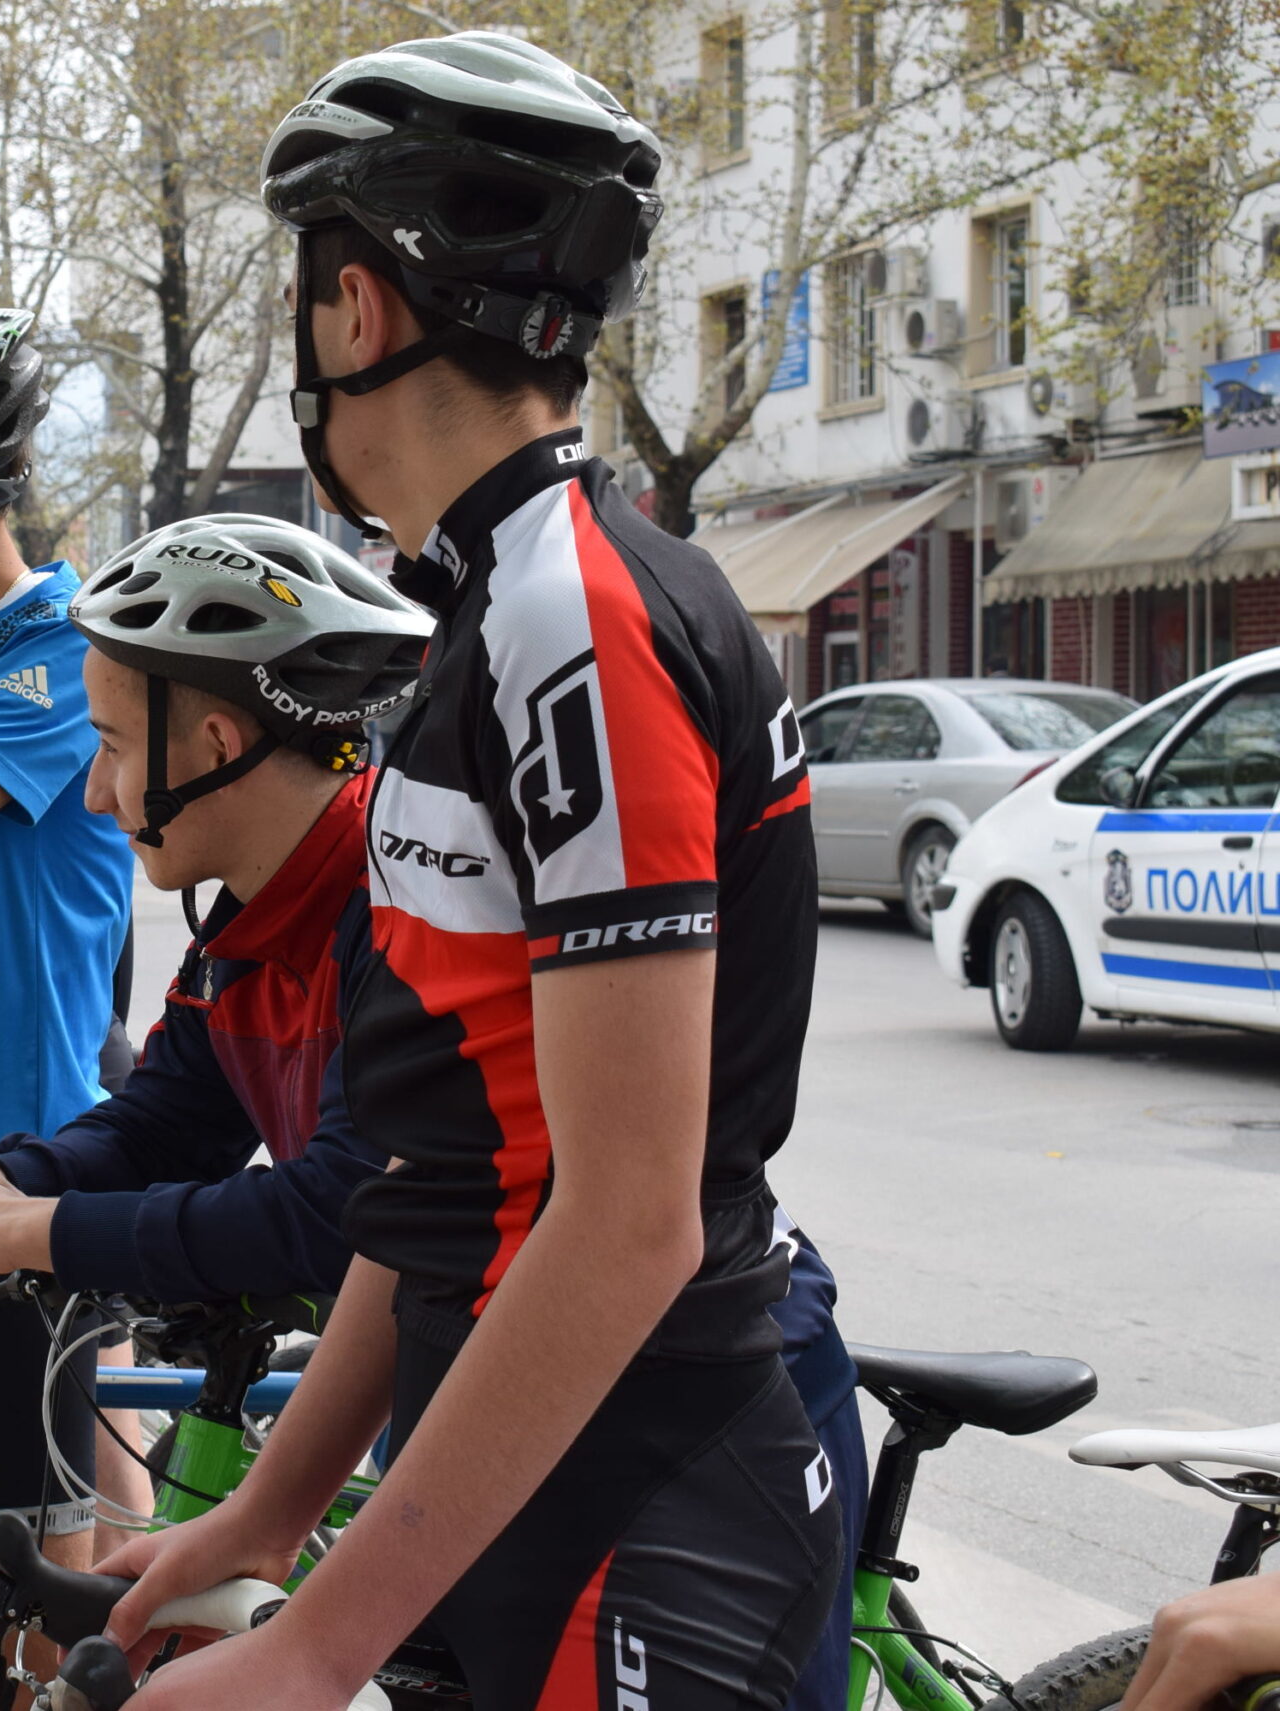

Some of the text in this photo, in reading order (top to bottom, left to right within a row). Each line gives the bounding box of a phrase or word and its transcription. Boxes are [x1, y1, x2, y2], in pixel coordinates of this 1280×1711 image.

[156, 544, 288, 582] RUDY
[252, 664, 397, 726] RUDY PROJECT
[380, 830, 485, 878] DRAG
[562, 911, 714, 953] DRAG
